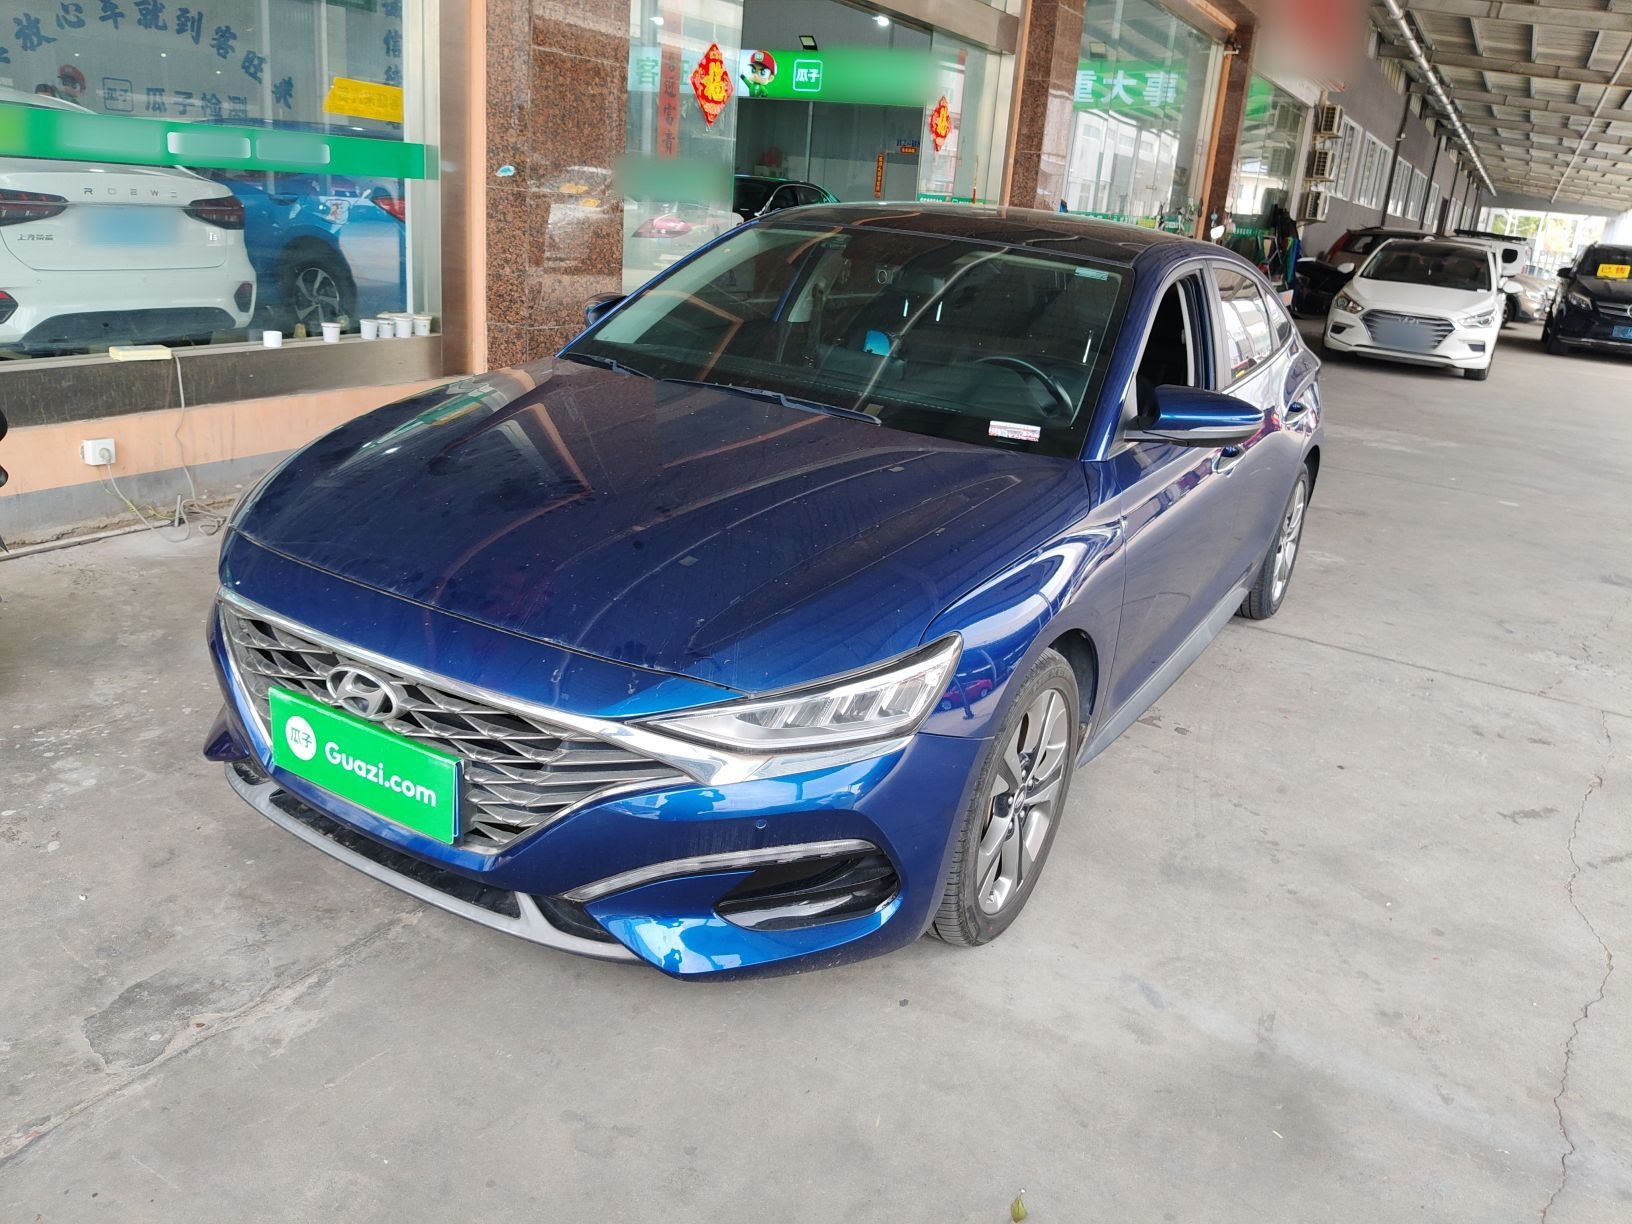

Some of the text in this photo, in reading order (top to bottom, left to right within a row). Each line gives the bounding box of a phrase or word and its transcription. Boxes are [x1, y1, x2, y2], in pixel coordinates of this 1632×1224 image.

[0, 0, 294, 111] 放心车就到客旺来
[796, 68, 820, 83] 瓜子
[703, 61, 727, 101] 福
[290, 727, 313, 749] 瓜子
[324, 741, 437, 808] Guazi.com
